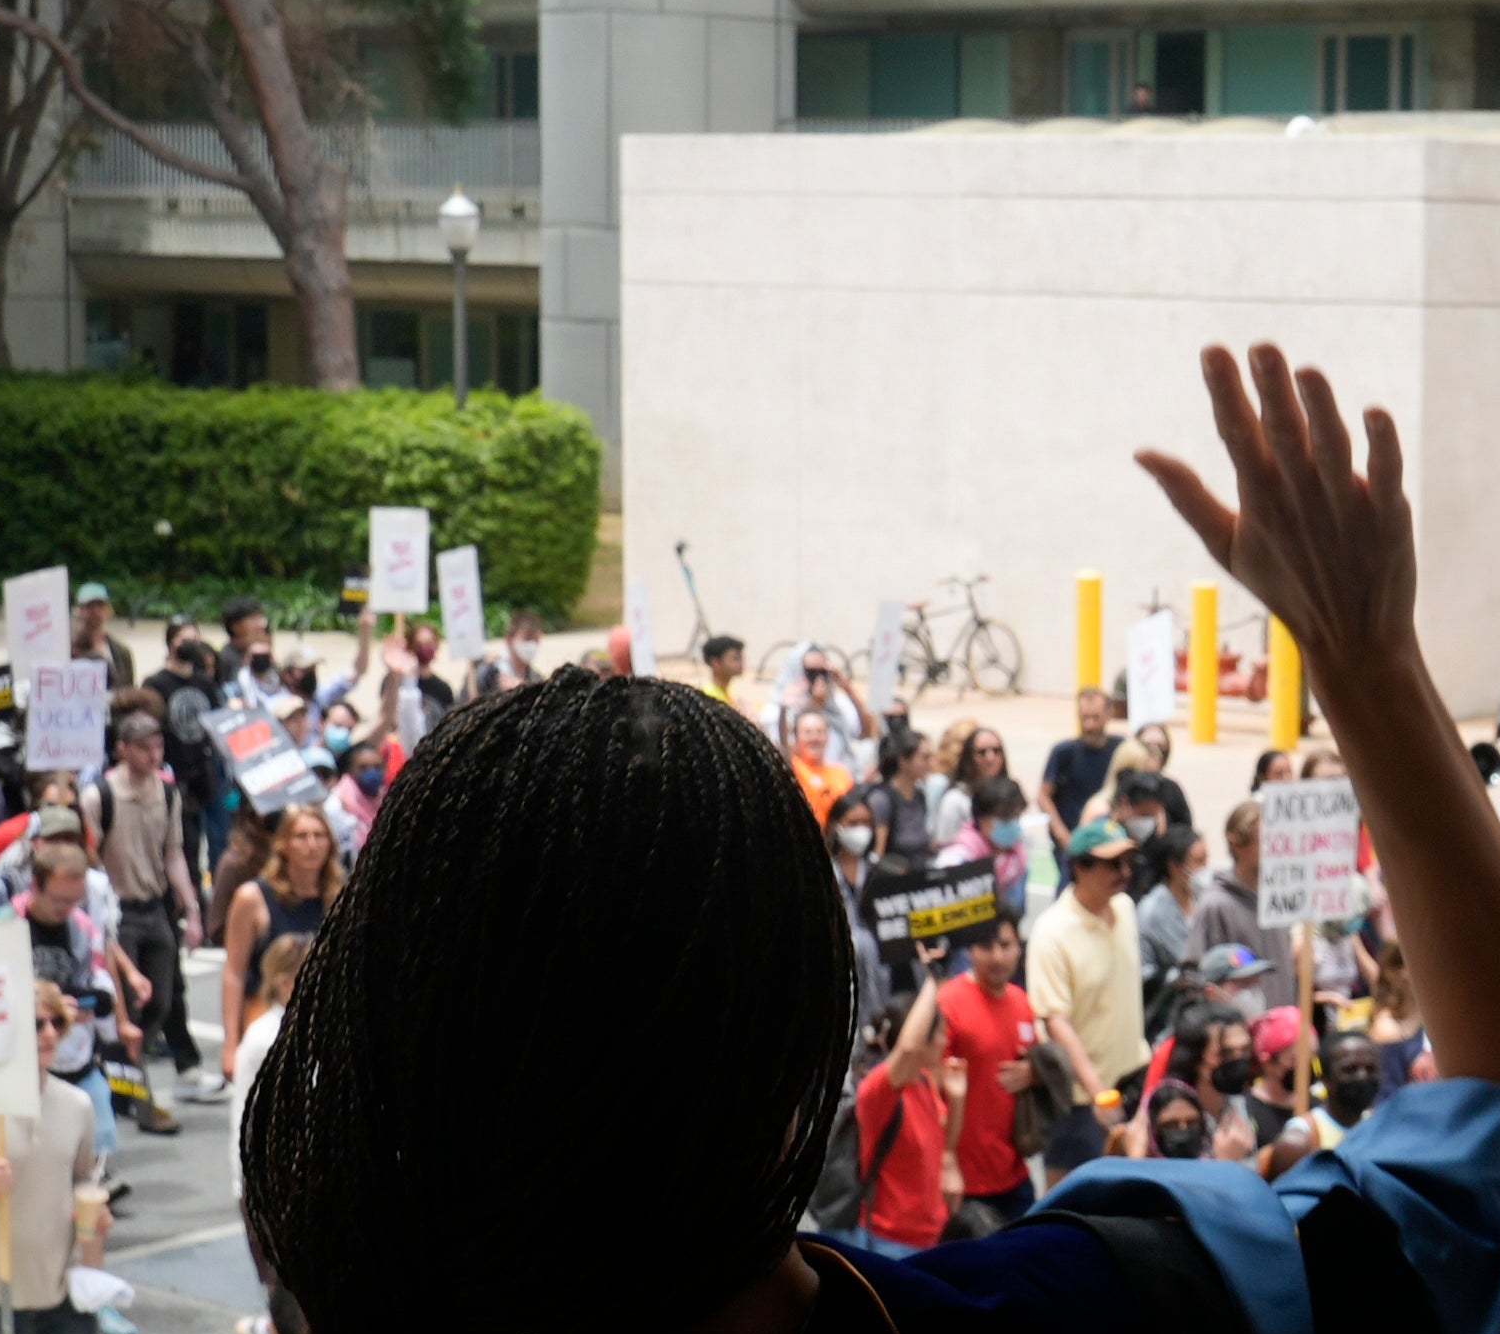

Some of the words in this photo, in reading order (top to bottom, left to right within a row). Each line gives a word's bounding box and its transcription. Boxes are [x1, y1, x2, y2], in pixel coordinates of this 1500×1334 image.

[37, 669, 101, 702] FUCK
[36, 707, 95, 730] UCLA
[874, 892, 910, 919] WE
[910, 884, 957, 910] WILL
[957, 873, 994, 899] NOT
[1266, 888, 1306, 915] AND
